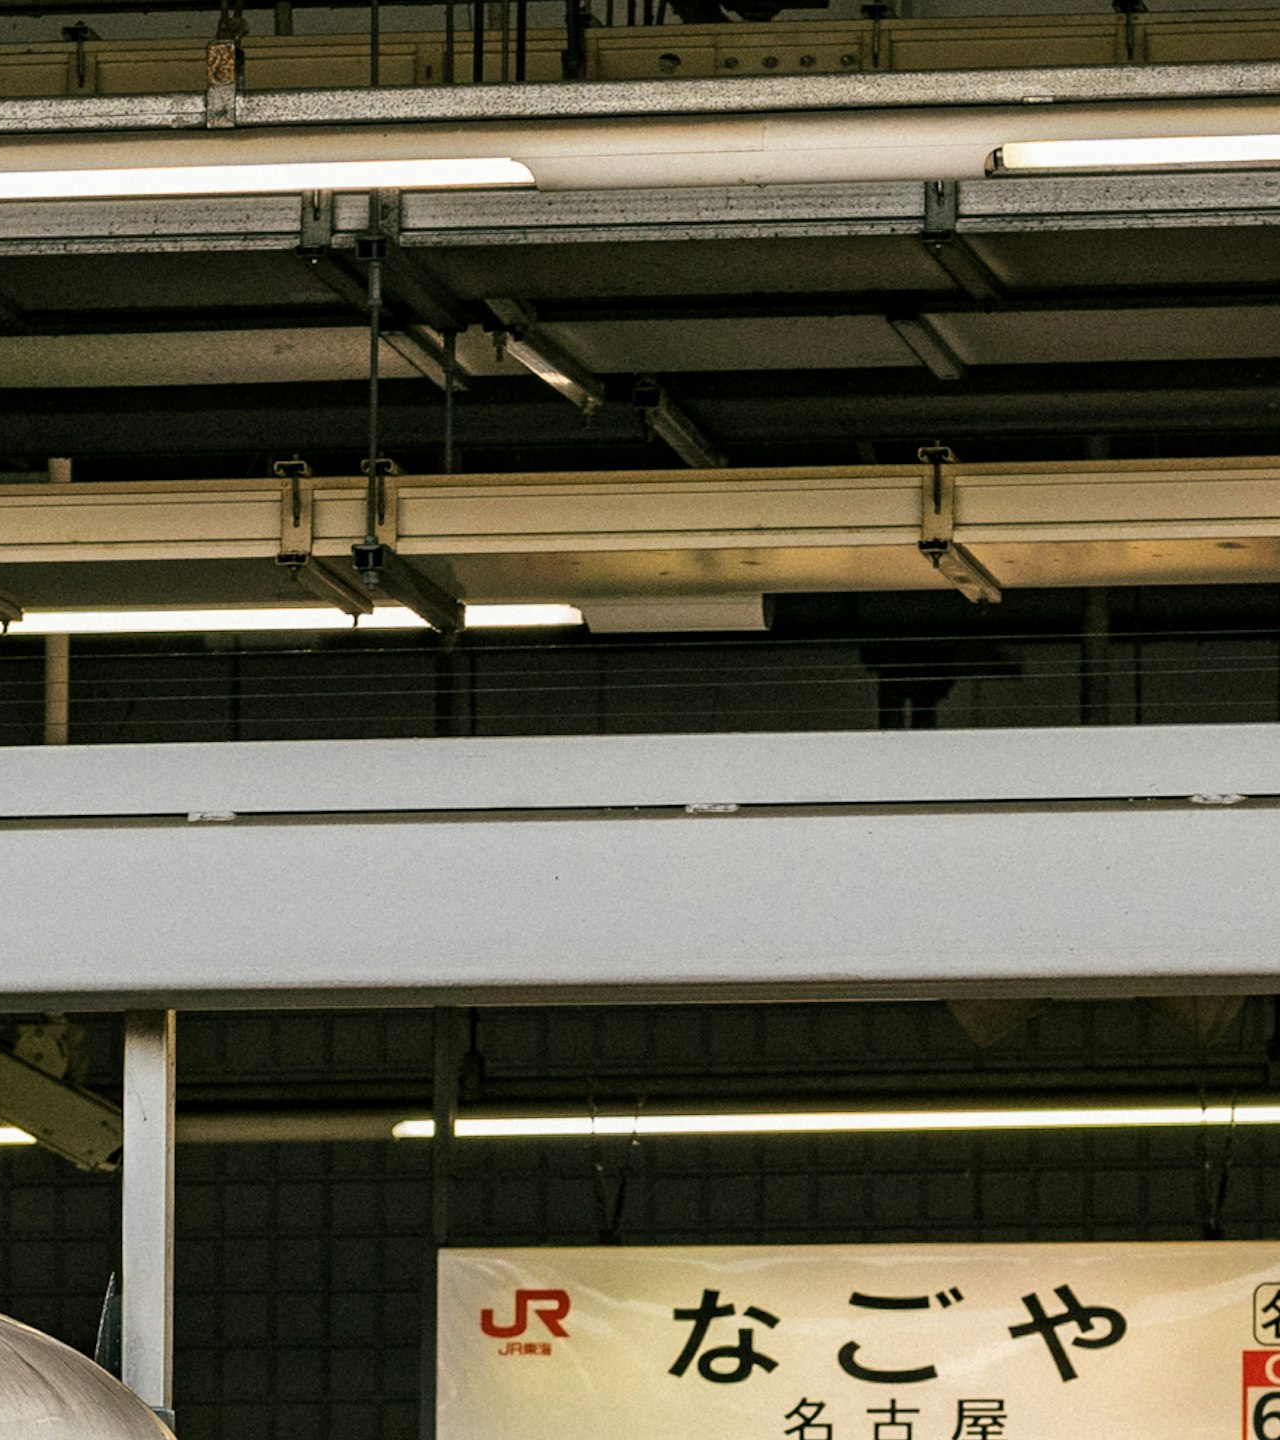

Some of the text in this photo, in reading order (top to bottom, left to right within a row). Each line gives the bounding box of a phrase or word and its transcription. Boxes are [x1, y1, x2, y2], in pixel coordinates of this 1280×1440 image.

[481, 1289, 570, 1338] JR
[667, 1284, 1127, 1383] なごや
